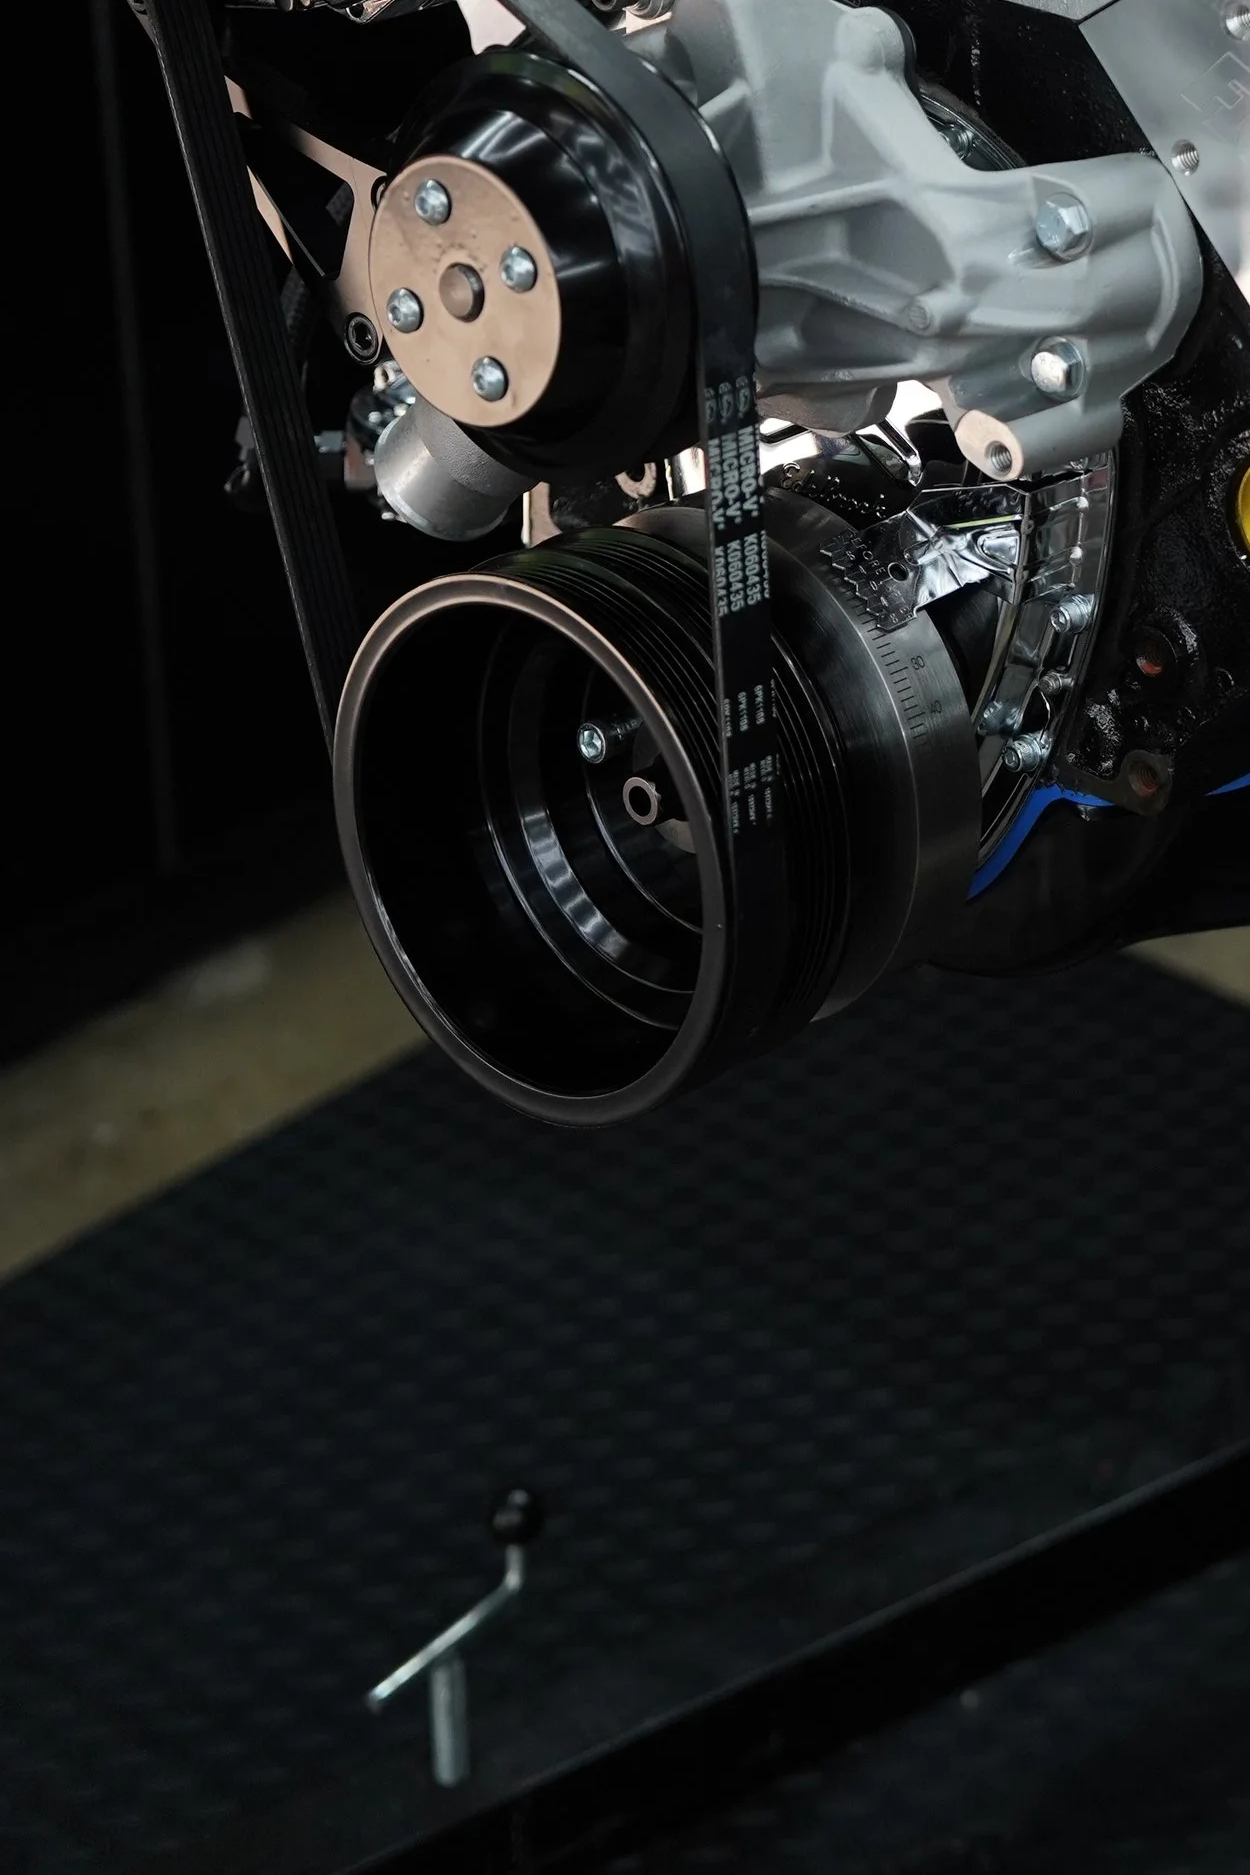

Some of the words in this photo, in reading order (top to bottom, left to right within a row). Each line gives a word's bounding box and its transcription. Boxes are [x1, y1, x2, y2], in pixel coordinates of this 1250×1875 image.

[727, 539, 745, 613] K060435
[744, 532, 761, 607] K060435
[910, 655, 926, 671] 30
